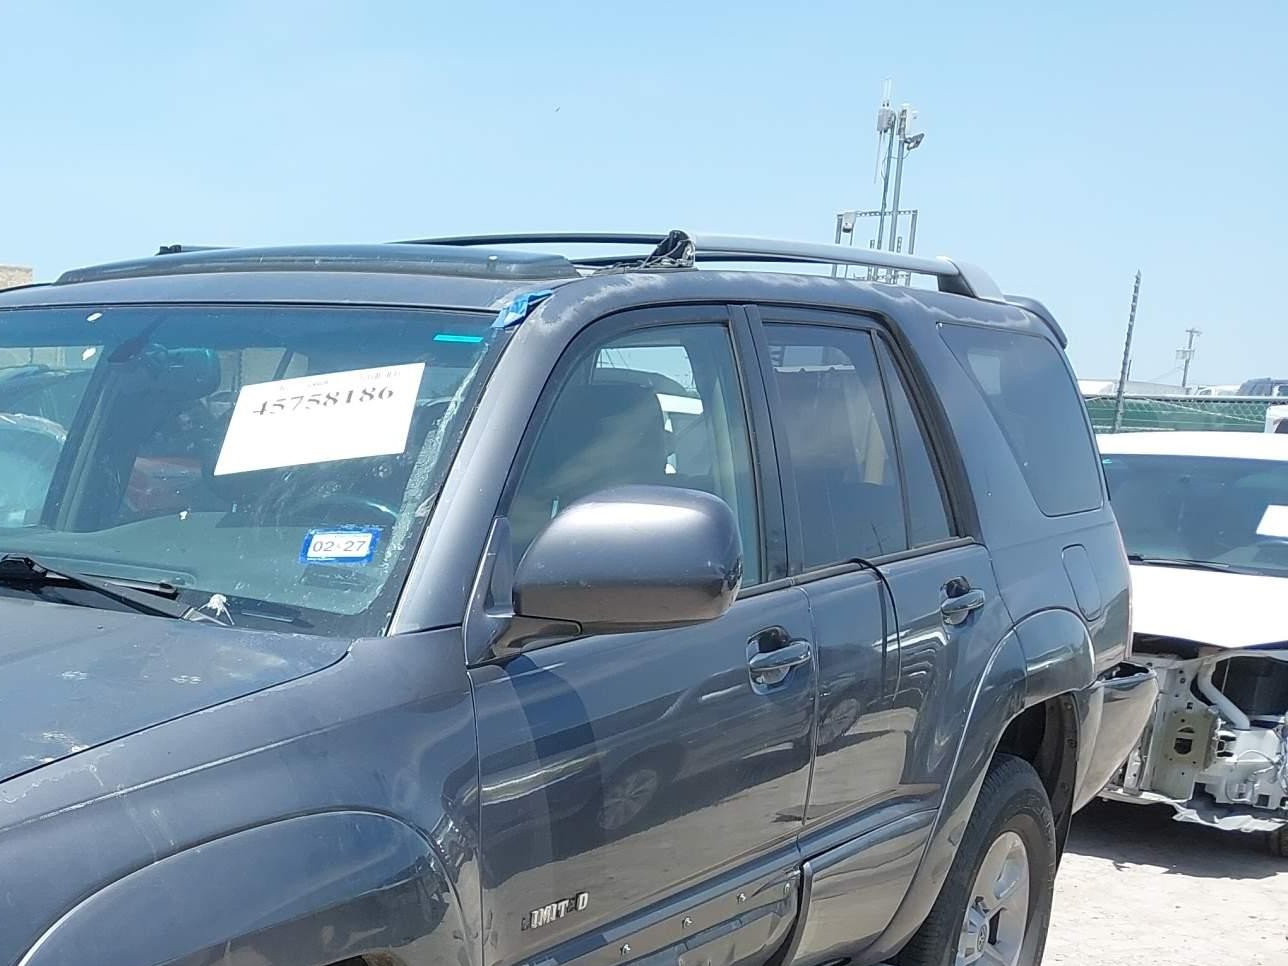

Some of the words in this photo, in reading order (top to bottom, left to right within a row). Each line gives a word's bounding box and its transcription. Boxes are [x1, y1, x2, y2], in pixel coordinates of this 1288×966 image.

[252, 385, 394, 416] 45758186
[312, 540, 335, 553] 02
[343, 540, 367, 553] 27
